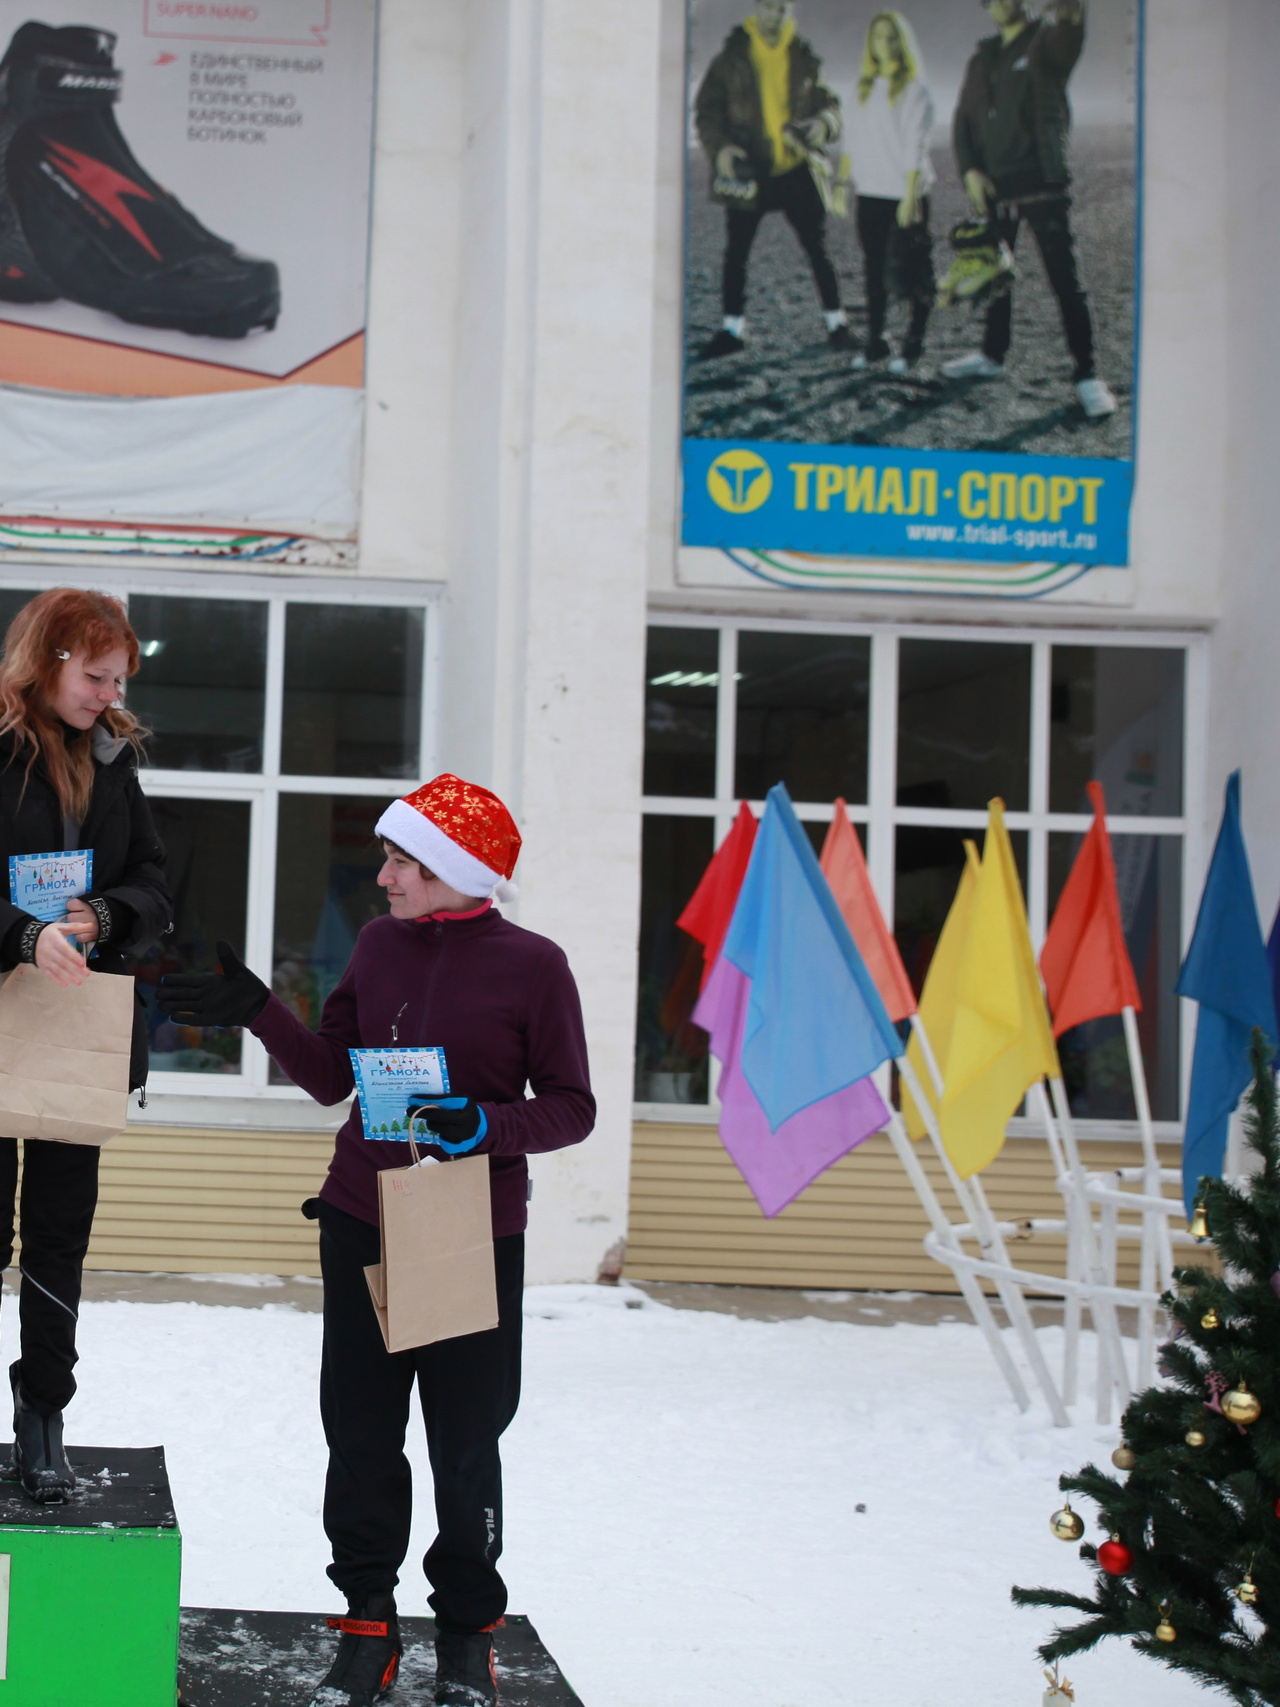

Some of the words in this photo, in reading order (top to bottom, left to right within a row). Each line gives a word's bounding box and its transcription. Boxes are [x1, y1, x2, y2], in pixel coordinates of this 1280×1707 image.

[905, 523, 1097, 551] www.trial-sport.ru
[24, 879, 77, 894] ГРАМОТА
[370, 1068, 431, 1077] ГРАМОТА
[484, 1507, 495, 1544] FILA
